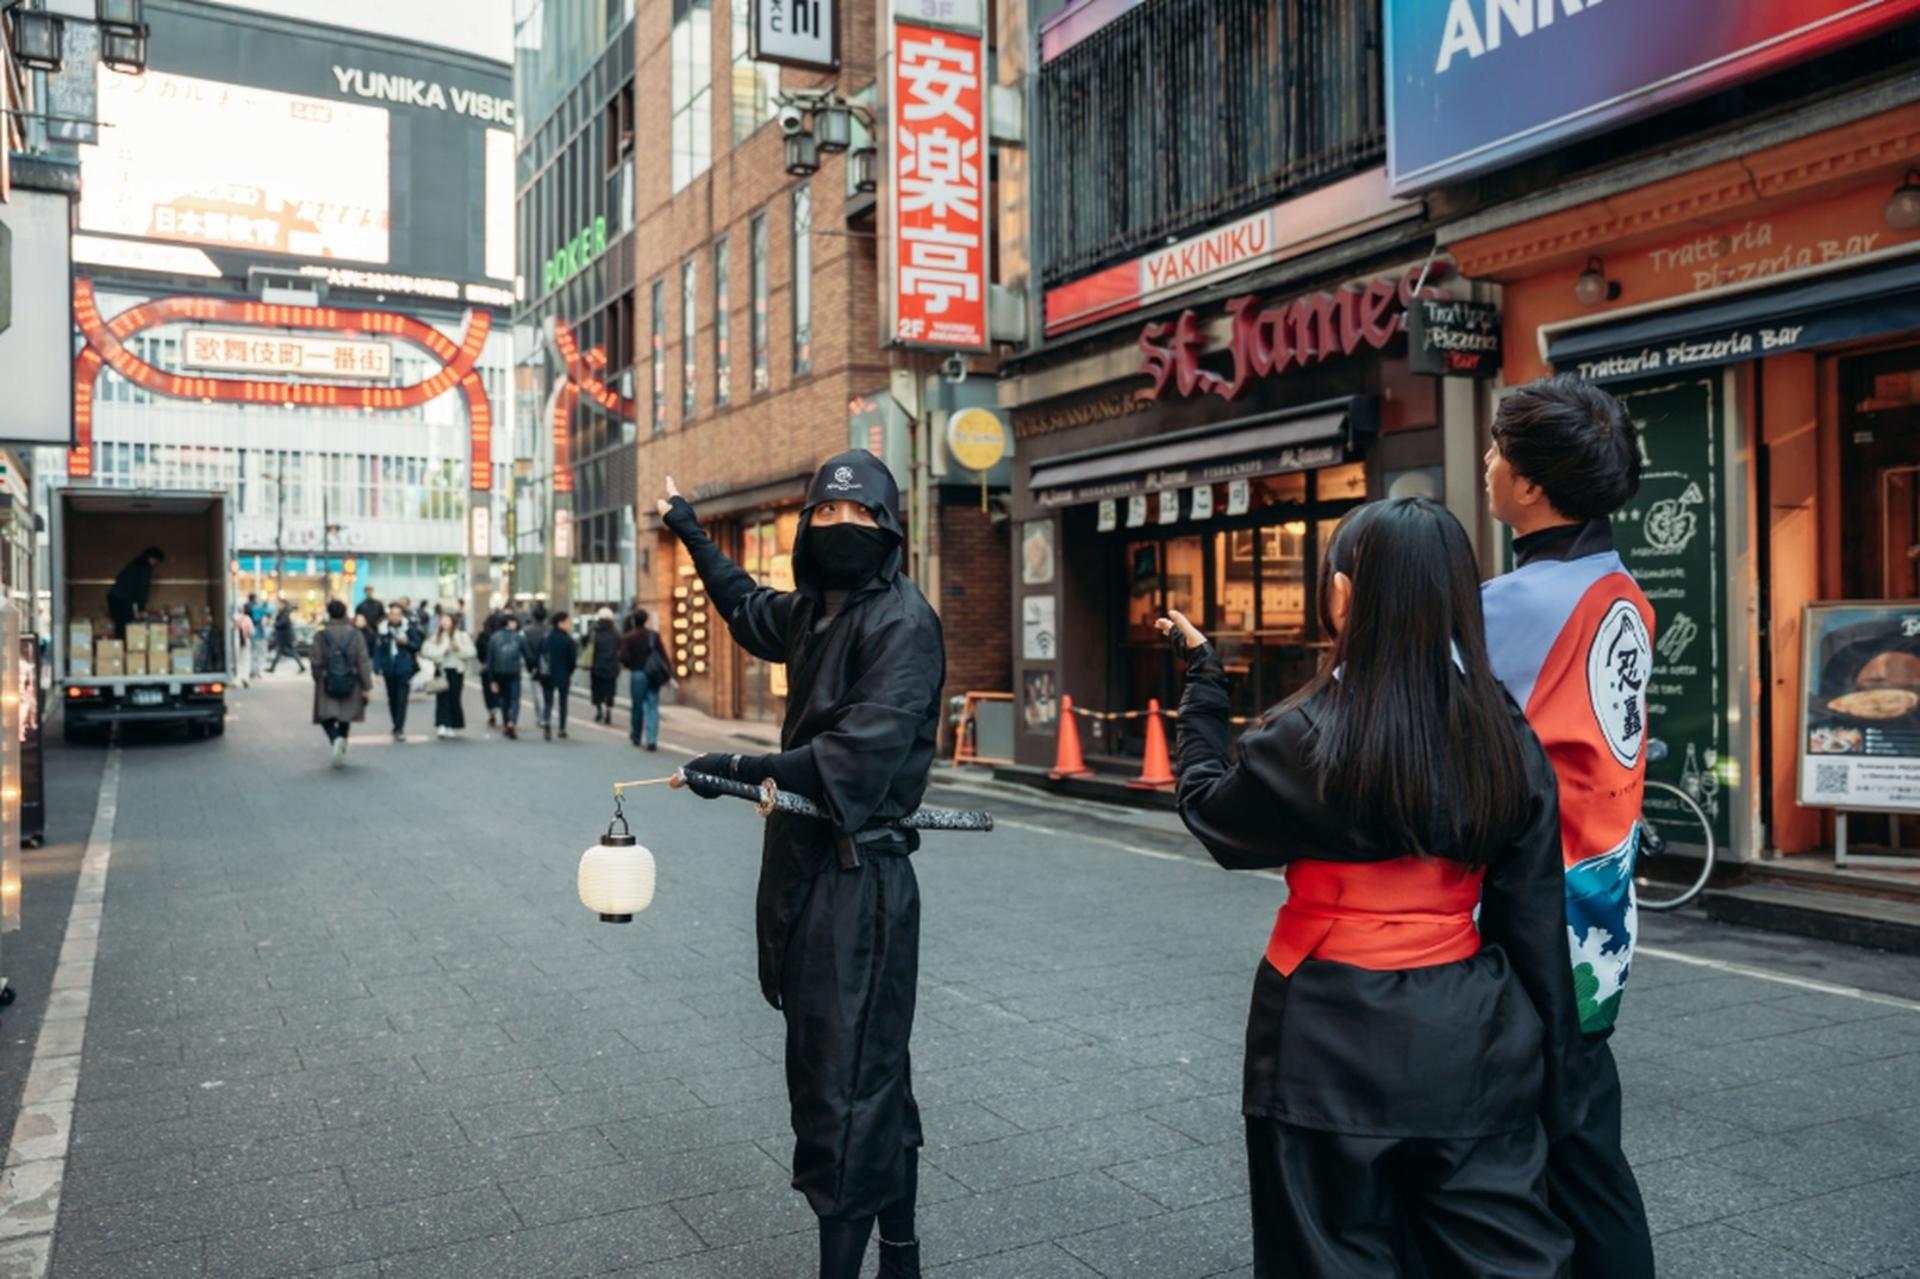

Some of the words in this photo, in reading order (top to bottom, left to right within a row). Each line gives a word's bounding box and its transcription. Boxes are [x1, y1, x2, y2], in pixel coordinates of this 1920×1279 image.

[332, 65, 448, 111] YUNIKA
[898, 37, 979, 315] 安楽亭
[544, 215, 607, 295] POKER
[1147, 218, 1266, 288] YAKINIKU
[1650, 223, 1772, 272] Trattria
[193, 336, 385, 372] 歌舞伎町一番街
[899, 318, 925, 338] 2F
[1578, 350, 1661, 380] Trattoria
[1666, 331, 1753, 367] Pizzeria
[1759, 325, 1804, 351] Bar
